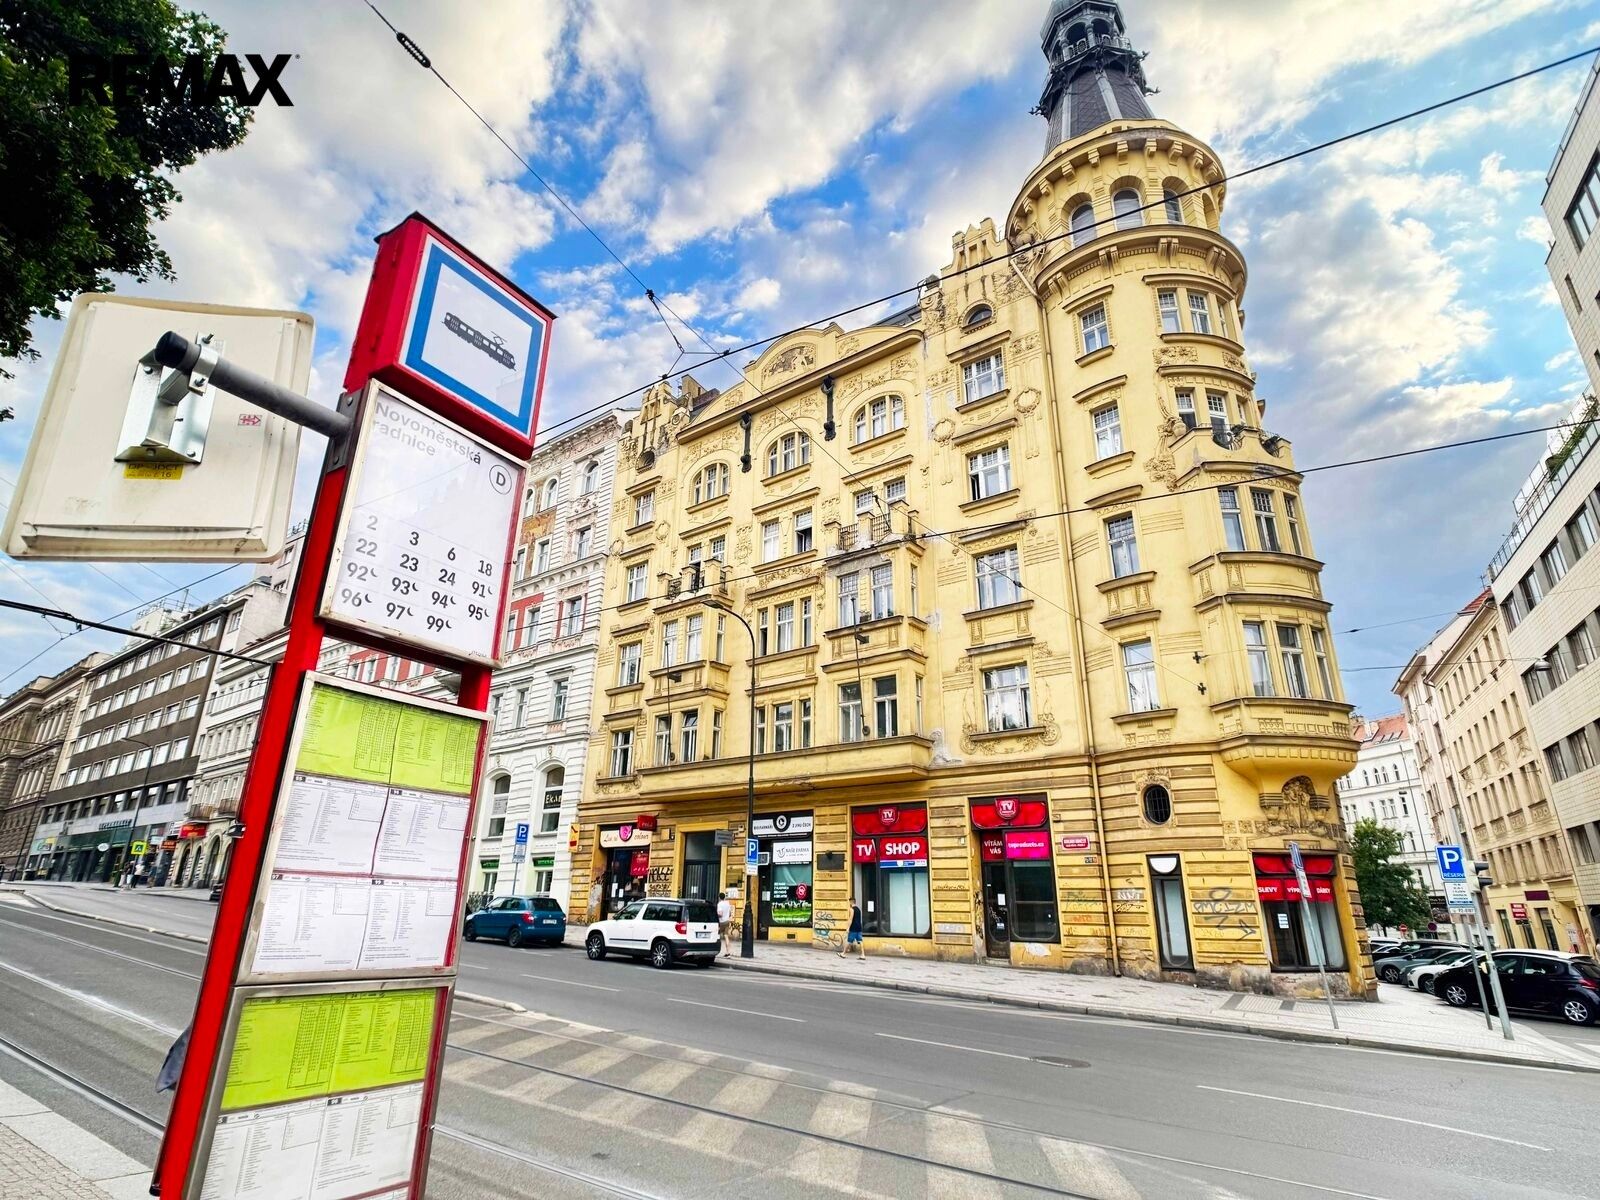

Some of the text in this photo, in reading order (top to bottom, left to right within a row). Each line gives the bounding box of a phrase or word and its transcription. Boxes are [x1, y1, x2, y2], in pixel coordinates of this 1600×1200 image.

[373, 420, 436, 457] radnice
[376, 402, 481, 465] Novoměstská
[355, 538, 486, 598] 22 23 24 91
[367, 515, 493, 577] 2 3 6 18
[341, 588, 444, 632] 96 97 99
[347, 562, 483, 621] 92 93 94 95
[856, 842, 920, 857] TV SHOP
[990, 847, 1002, 855] VÁS
[1441, 850, 1460, 870] P
